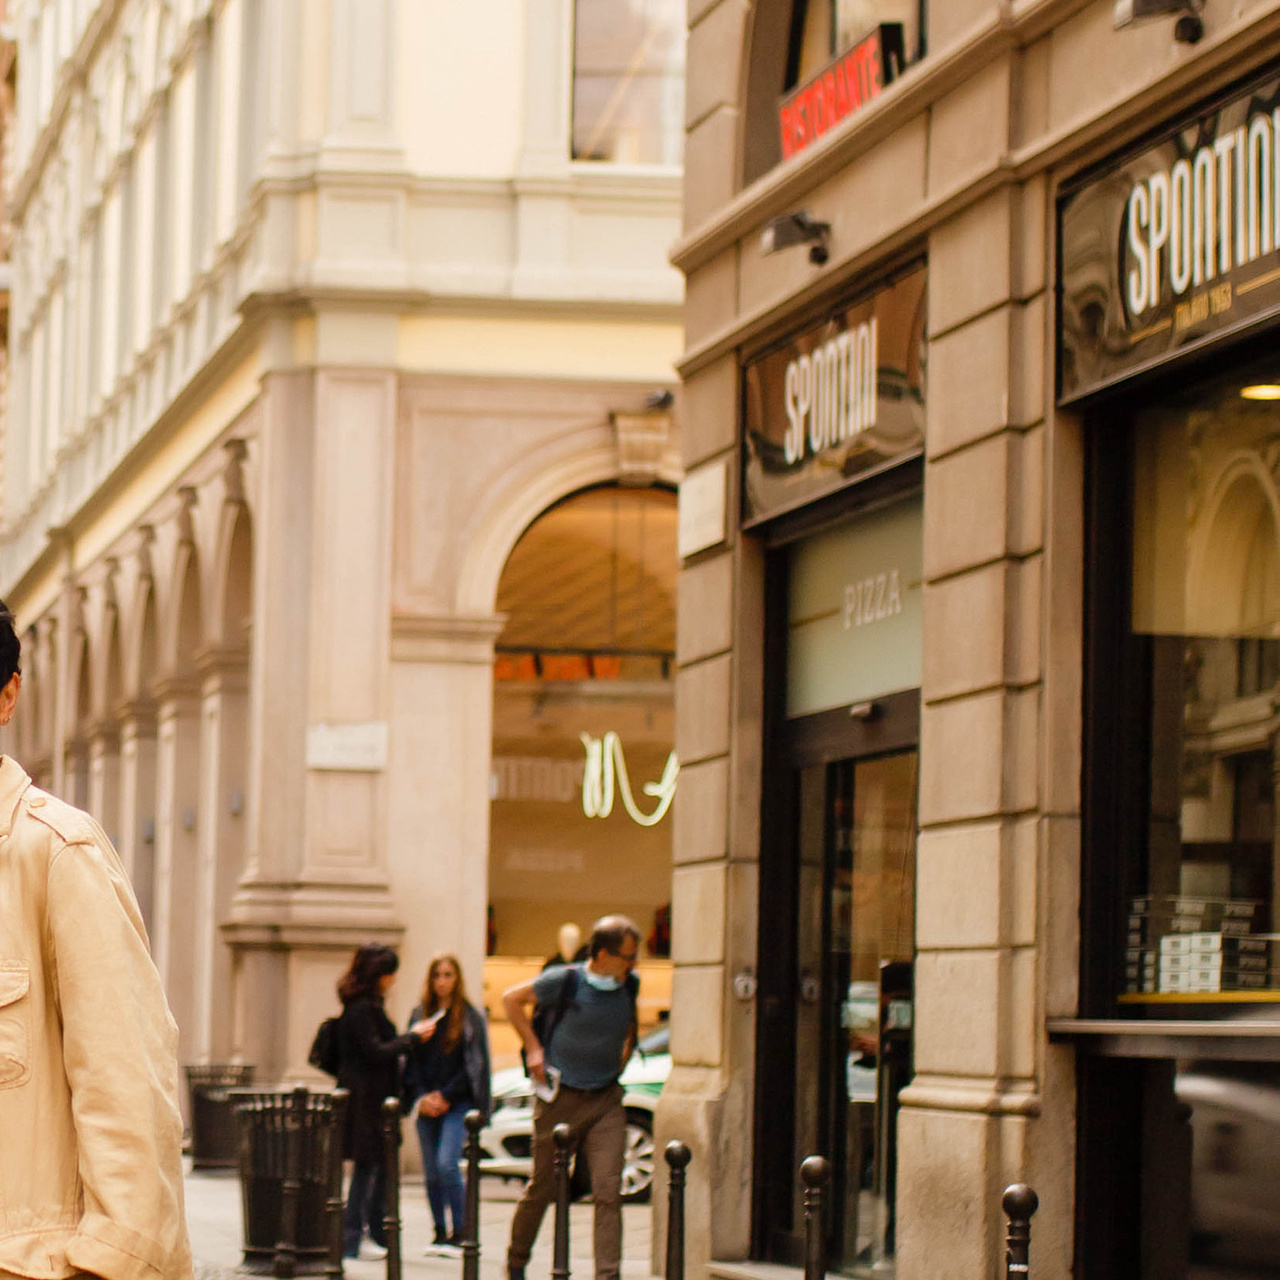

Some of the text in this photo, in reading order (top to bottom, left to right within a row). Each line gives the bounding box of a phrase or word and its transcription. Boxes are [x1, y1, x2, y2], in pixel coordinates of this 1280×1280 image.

[780, 35, 882, 161] RISTORANTE
[784, 316, 879, 465] SPONTINI
[843, 569, 902, 631] PIZZA
